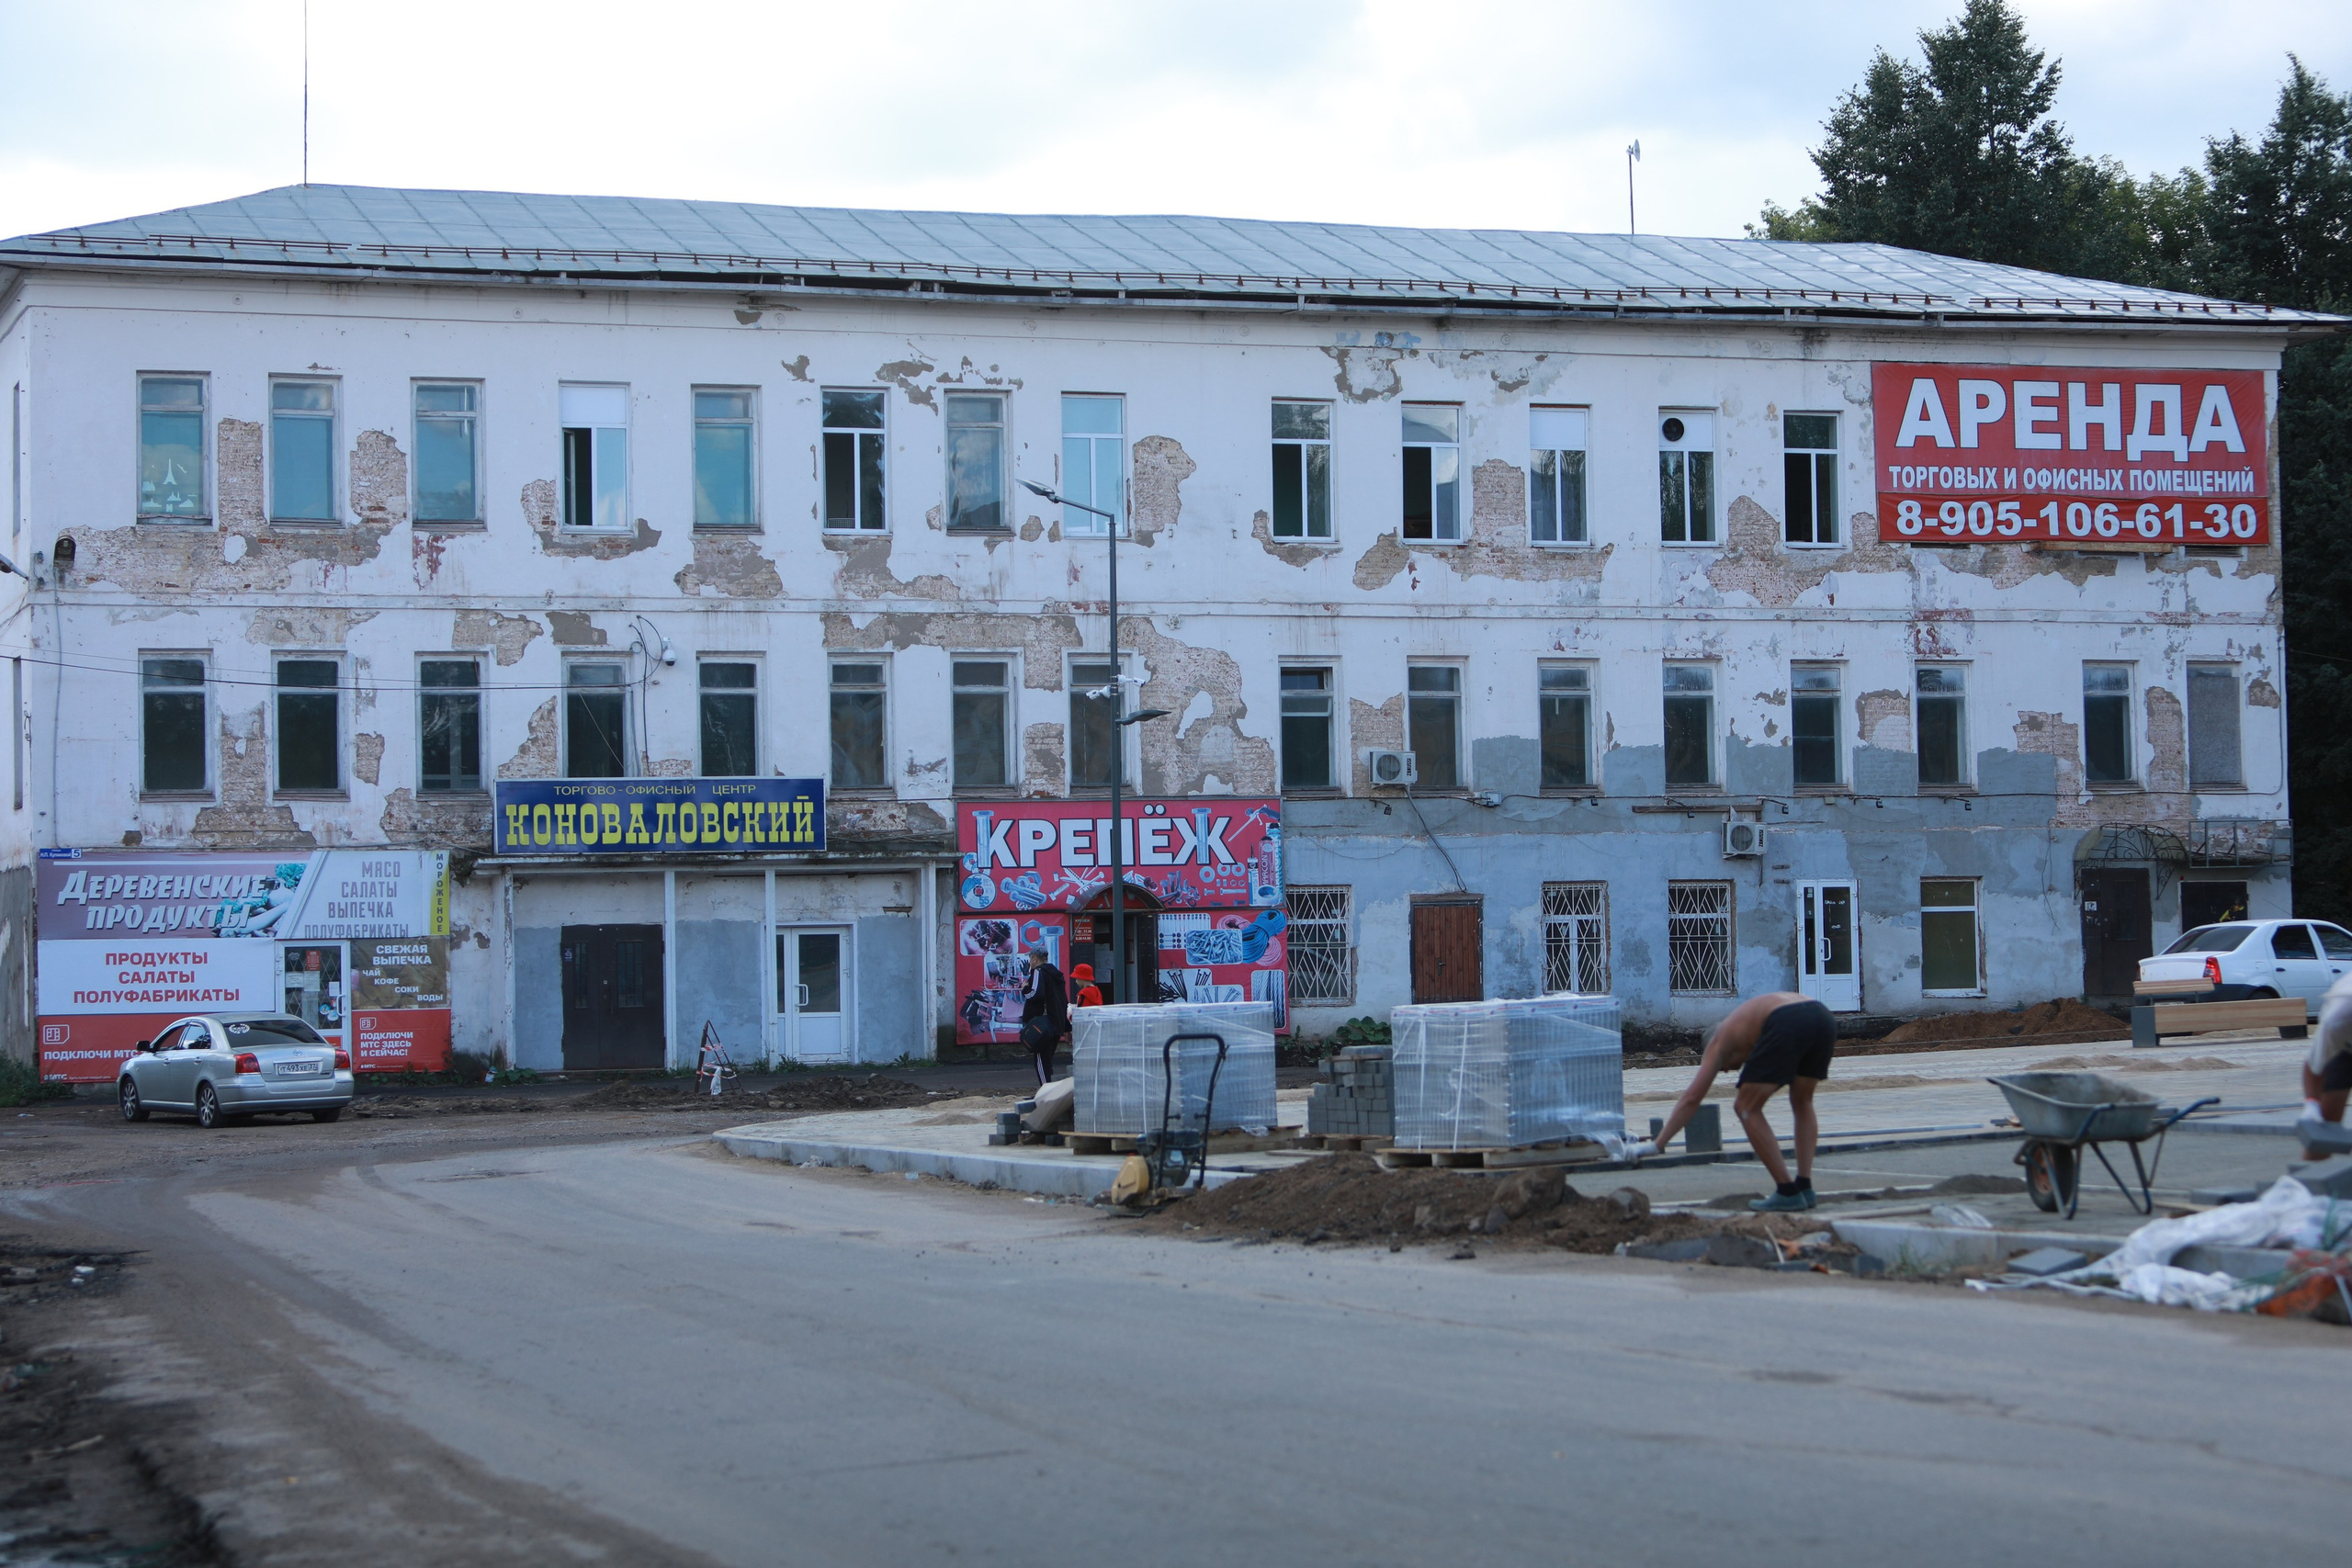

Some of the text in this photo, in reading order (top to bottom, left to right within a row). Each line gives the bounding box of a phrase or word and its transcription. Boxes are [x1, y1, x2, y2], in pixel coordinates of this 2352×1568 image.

[1894, 378, 2246, 462] АРЕНДА
[1888, 465, 2255, 496] ТОРГОВЫХ И ОФИСНЫХ ПОМЕЩЕНИЙ
[1896, 499, 2257, 538] 8-905-106-61-30
[712, 784, 756, 796] ЦЕНТР
[505, 795, 815, 846] КОНОВАЛОВСКИЙ
[972, 803, 1238, 868] КРЕПЁЖ
[74, 849, 80, 857] 5
[362, 861, 401, 877] МЯСО
[57, 870, 266, 906] ДЕРЕВЕНСКИЕ
[341, 881, 398, 897] САЛАТЫ
[435, 853, 444, 932] МОРОЖЕНОЕ
[328, 901, 394, 919] ВЫПЕЧКА
[85, 904, 252, 933] ПРОДУКТЫ
[304, 923, 409, 939] ПОЛУФАБРИКАТЫ
[376, 944, 428, 954] СВЕЖАЯ
[105, 952, 208, 967] ПРОДУКТЫ
[372, 955, 432, 965] ВЫПЕЧКА
[119, 970, 196, 984] САЛАТЫ
[362, 967, 381, 976] ЧАЙ
[74, 988, 240, 1004] ПОЛУФАБРИКАТЫ
[360, 1032, 413, 1040] ПОДКЛЮЧИ
[44, 1049, 139, 1060] ПОДКЛЮЧИ МТС
[369, 1048, 408, 1056] СЕЙЧАС!
